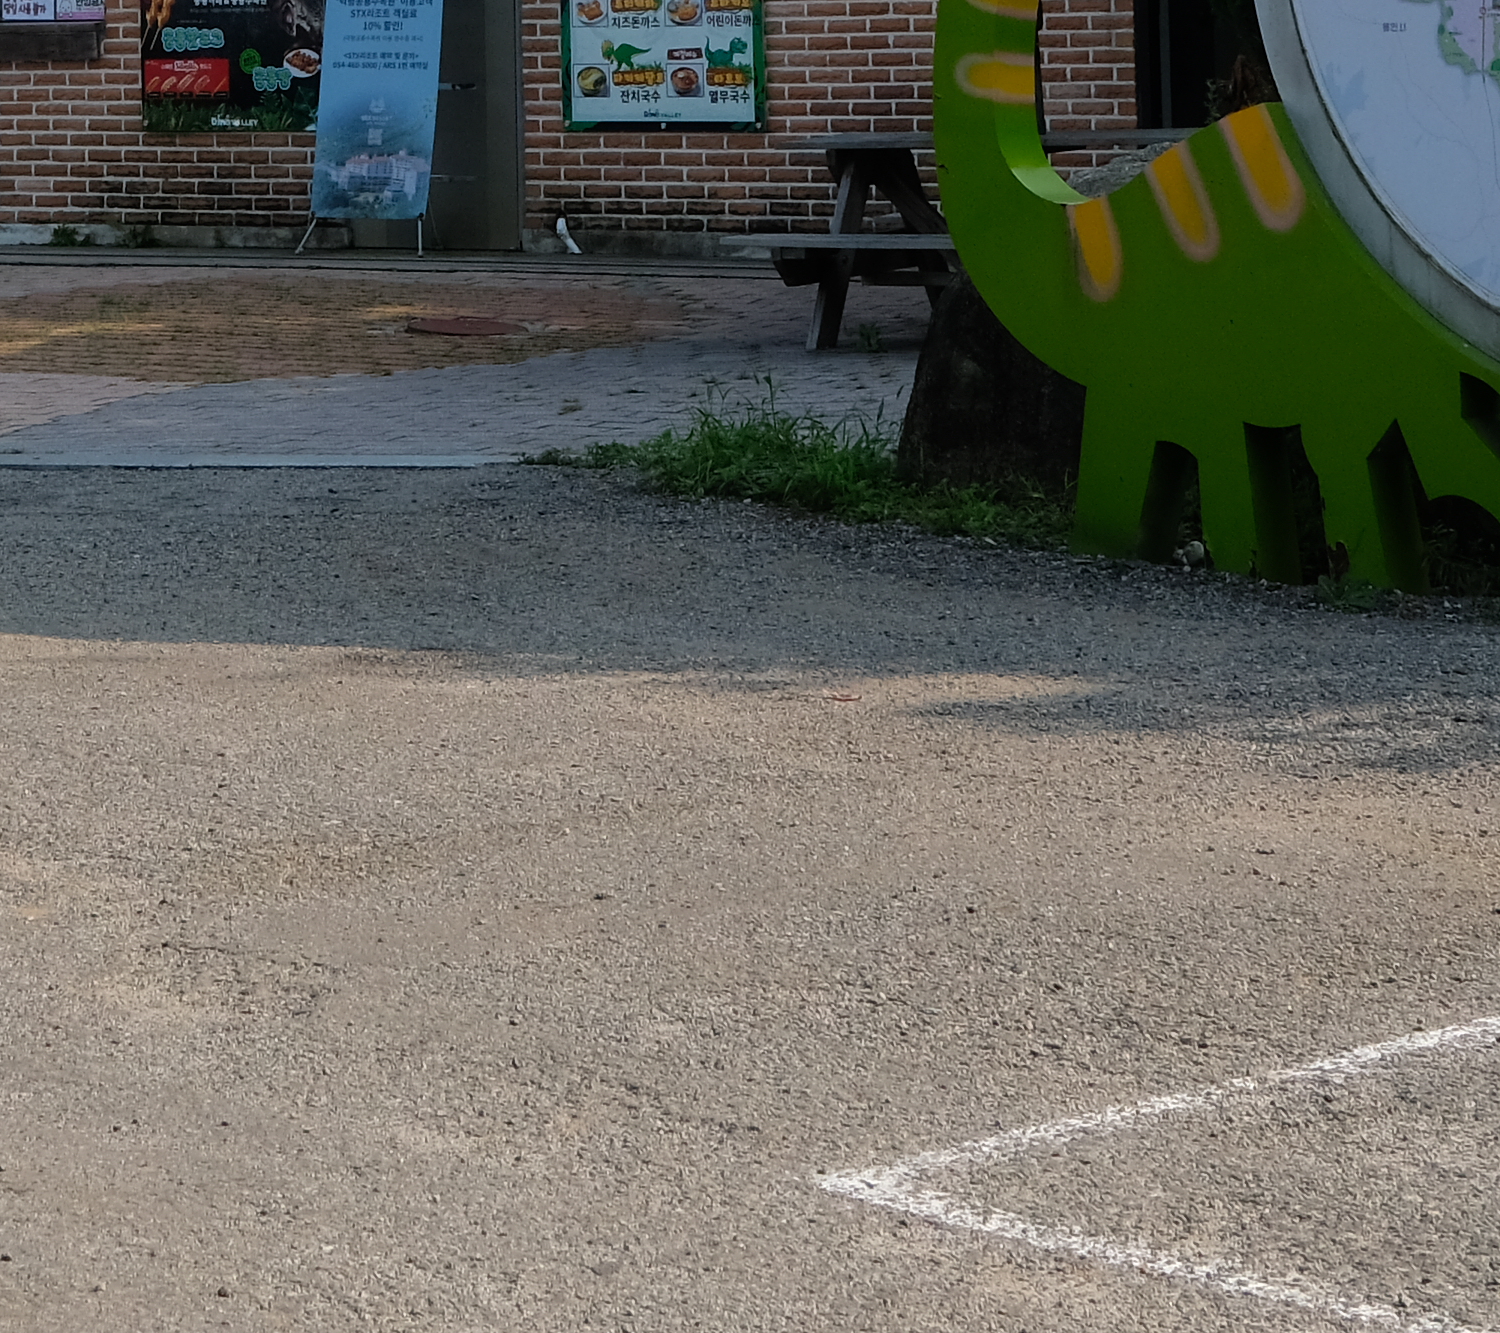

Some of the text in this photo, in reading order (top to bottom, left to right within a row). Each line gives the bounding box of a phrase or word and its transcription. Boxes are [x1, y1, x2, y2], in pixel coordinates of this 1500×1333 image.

[363, 21, 382, 31] 10%
[611, 16, 661, 29] 치즈돈까스
[620, 90, 661, 104] 잔치국수
[708, 90, 751, 104] 열무국수
